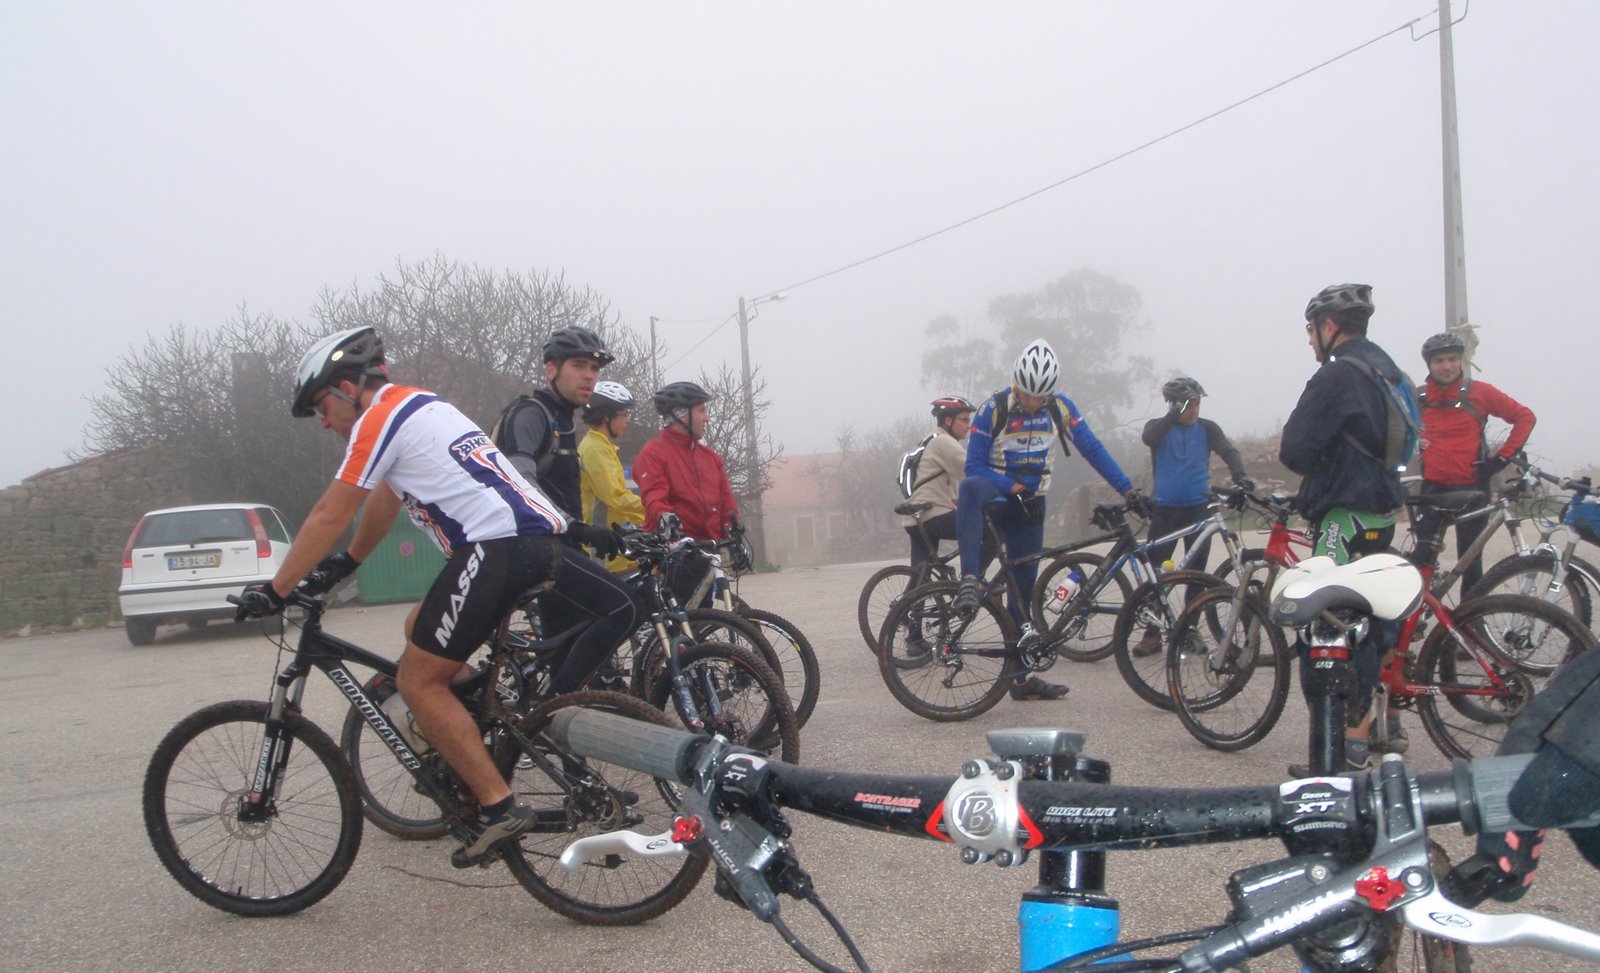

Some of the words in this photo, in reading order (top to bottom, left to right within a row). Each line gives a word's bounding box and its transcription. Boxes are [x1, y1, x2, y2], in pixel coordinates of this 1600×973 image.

[434, 541, 486, 649] MASSI
[328, 667, 421, 770] MONDRAKER
[724, 770, 747, 781] XT
[1082, 807, 1117, 818] LITE
[1295, 801, 1336, 813] XT
[1293, 821, 1347, 833] SHIMANO
